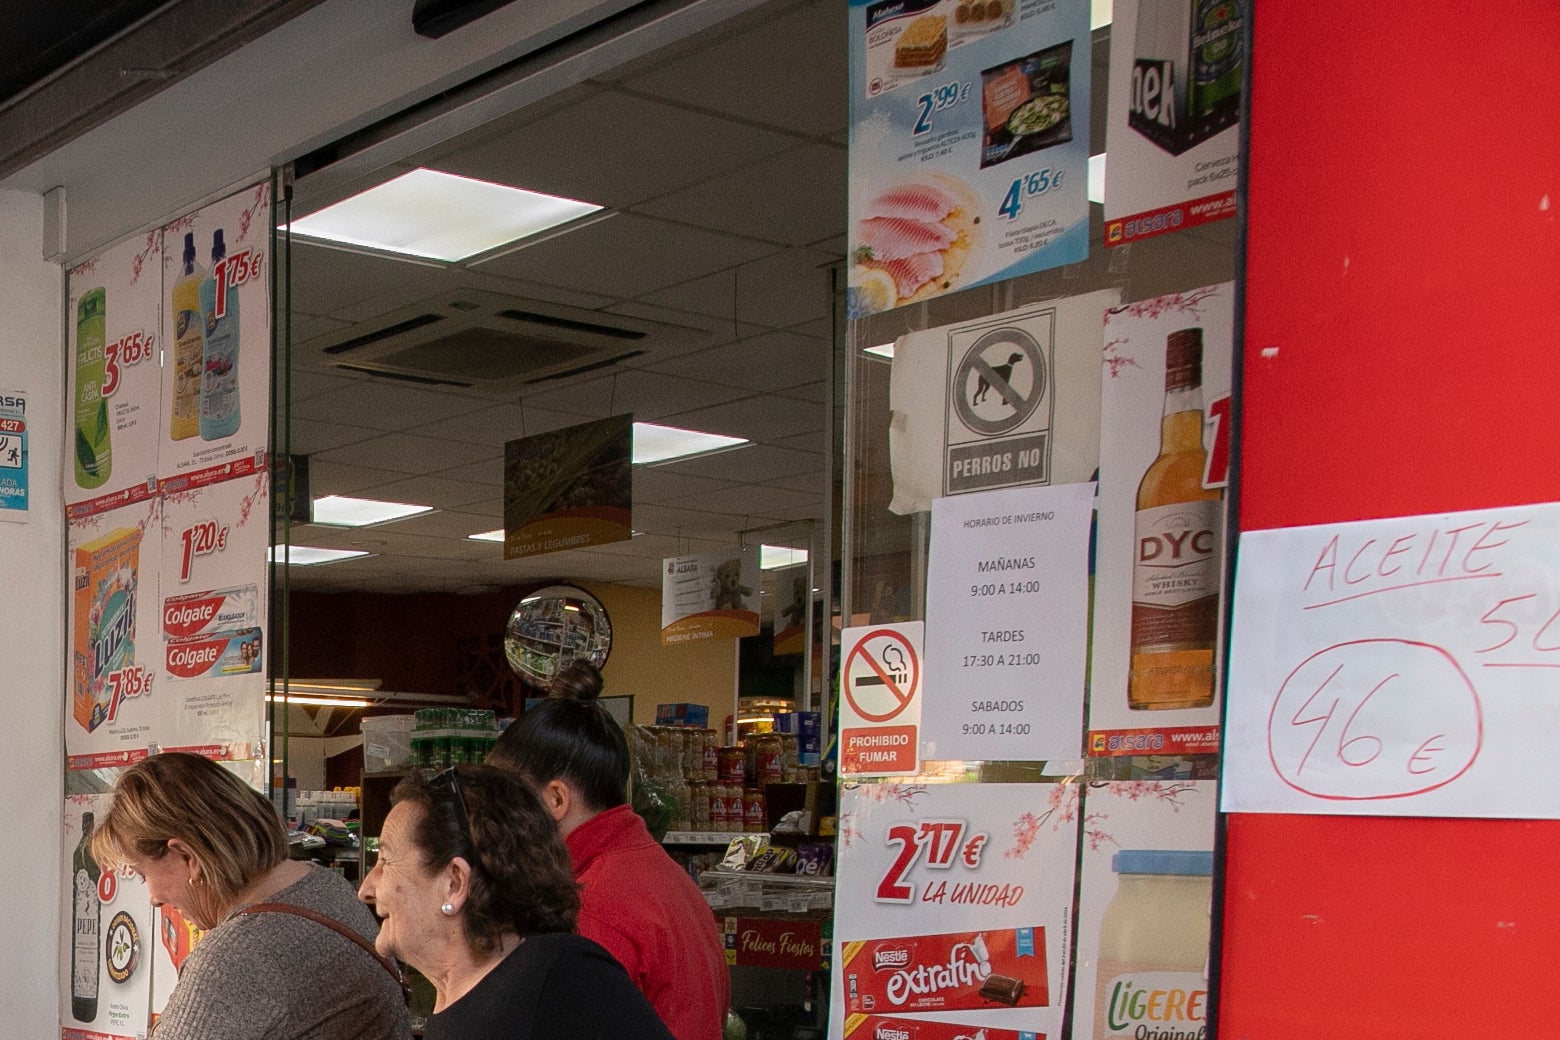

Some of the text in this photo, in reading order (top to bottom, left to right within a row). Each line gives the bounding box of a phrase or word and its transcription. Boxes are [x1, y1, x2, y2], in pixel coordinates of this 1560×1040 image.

[1, 420, 19, 431] 427
[953, 448, 1040, 479] PERROS NO
[964, 511, 1055, 529] HORARIO DE INVIERNO
[510, 543, 536, 555] PASTAS
[544, 534, 590, 550] LEGUMBRES
[1140, 529, 1214, 562] DYC
[978, 556, 1035, 573] MAÑANAS
[1303, 520, 1530, 592] ACEITE
[971, 581, 1040, 597] 9:00 A 14:00
[1152, 578, 1200, 590] WHISKY
[165, 604, 213, 627] Colgate
[981, 630, 1025, 643] TARDES
[169, 647, 218, 668] Colgate
[963, 653, 1040, 668] 17:30 A 21:00
[971, 700, 1024, 713] SABADOS
[1291, 664, 1399, 776] 46
[962, 723, 1031, 735] 9:00 A 14:00
[849, 733, 908, 749] PROHIBIDO
[859, 749, 897, 763] FUMAR
[922, 881, 1024, 908] LA UNIDAD
[77, 918, 97, 935] PEPE
[742, 930, 815, 958] Felices Fiestas
